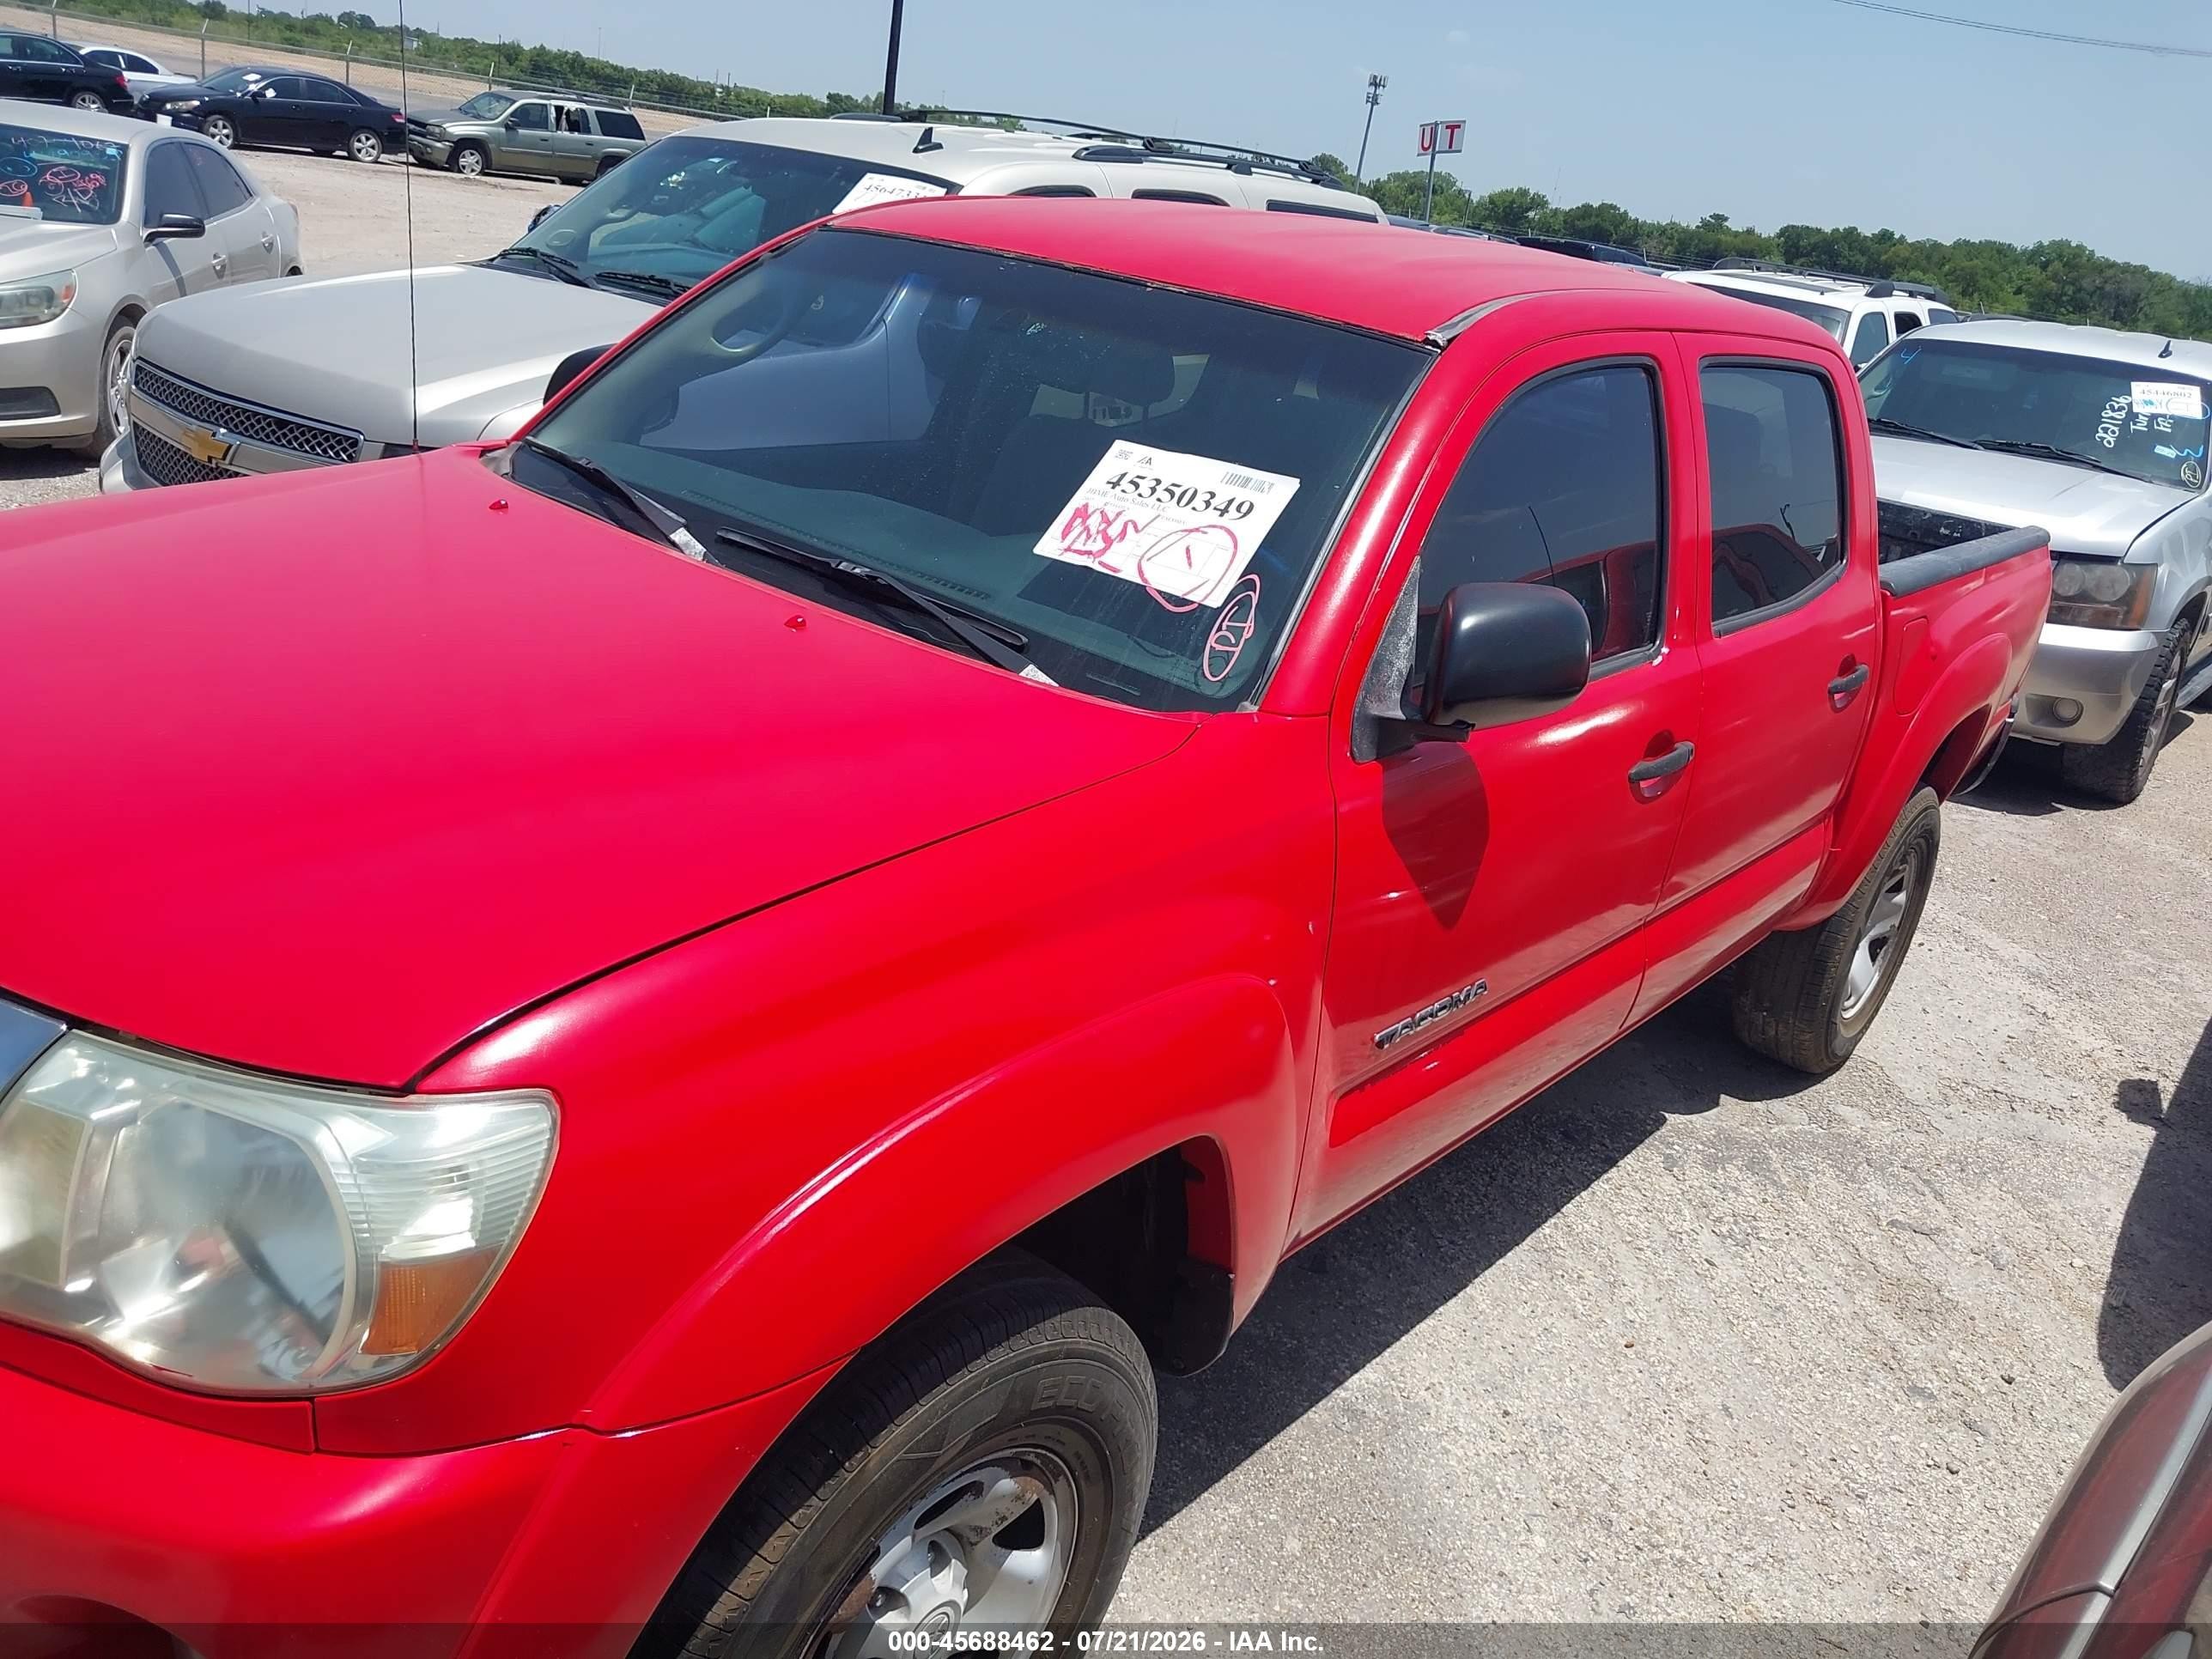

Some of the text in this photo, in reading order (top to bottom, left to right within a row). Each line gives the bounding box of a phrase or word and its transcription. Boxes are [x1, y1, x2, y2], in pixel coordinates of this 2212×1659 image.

[2095, 395, 2132, 448] 221836
[1105, 471, 1255, 520] 45350349
[1112, 493, 1133, 503] Auto
[1133, 497, 1150, 508] Sales
[1373, 977, 1489, 1050] TACOMA
